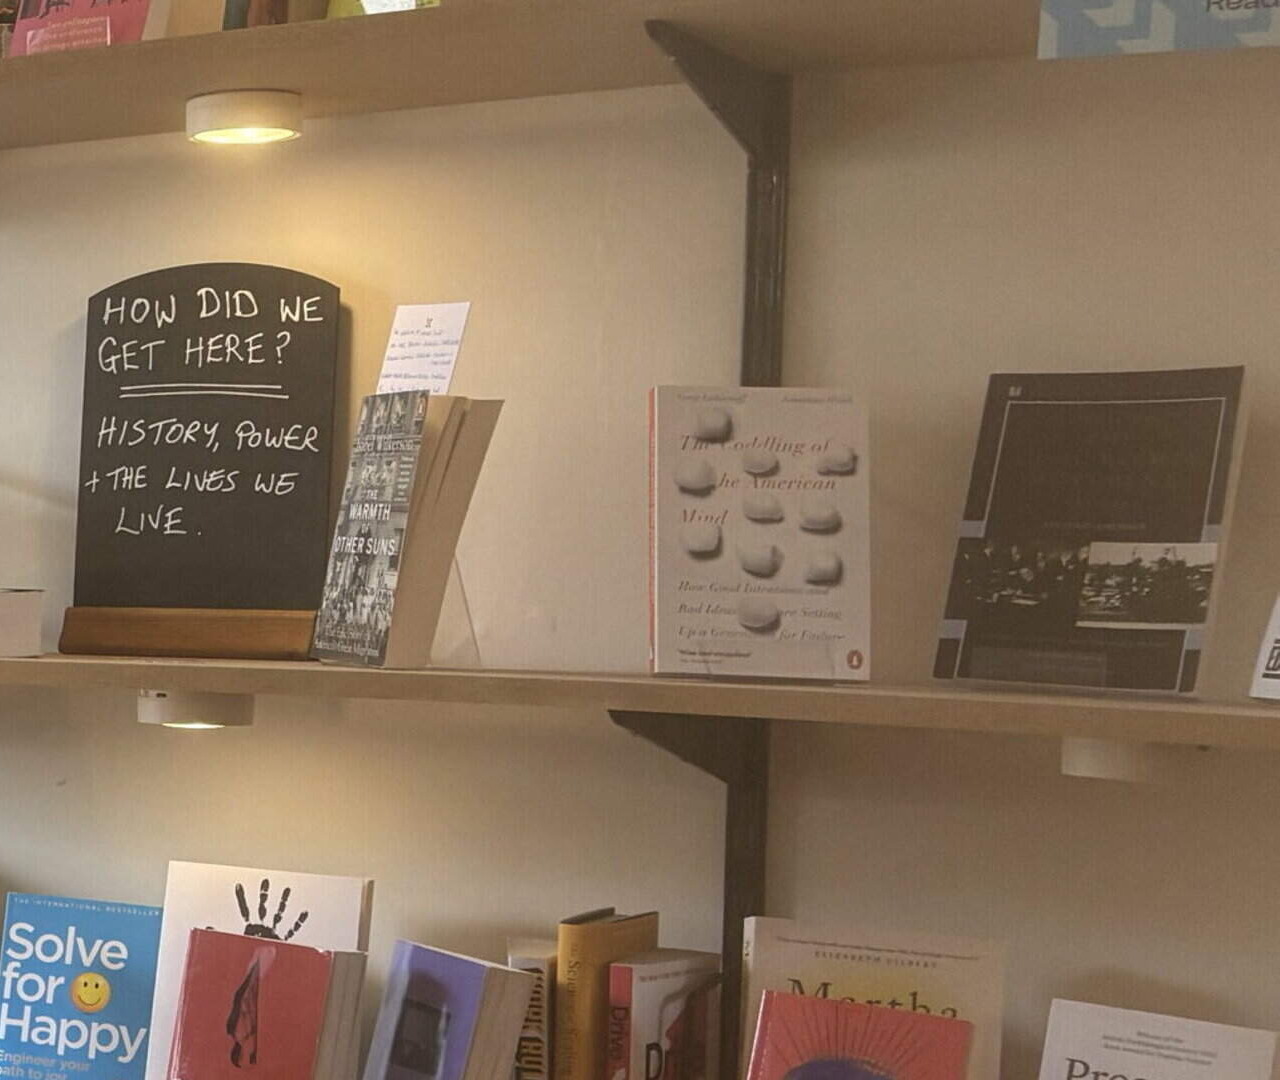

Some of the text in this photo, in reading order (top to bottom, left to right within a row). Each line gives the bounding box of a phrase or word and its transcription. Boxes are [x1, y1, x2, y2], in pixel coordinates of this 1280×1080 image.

[102, 287, 324, 328] HOW DID WE
[97, 336, 166, 373] GET
[97, 416, 319, 453] HISTORY, POWER
[720, 435, 829, 454] Coddling of
[105, 466, 300, 496] THE LIVES WE
[751, 475, 836, 490] American
[348, 503, 391, 521] WARMTH
[681, 509, 729, 525] Mind
[334, 536, 395, 556] OTHER SUNS
[5, 921, 129, 970] Solve
[815, 951, 938, 969] ELIZABETH GILBERT
[1, 961, 66, 1003] for
[608, 1005, 629, 1061] Drive
[28, 1067, 41, 1080] to
[60, 1059, 89, 1072] your
